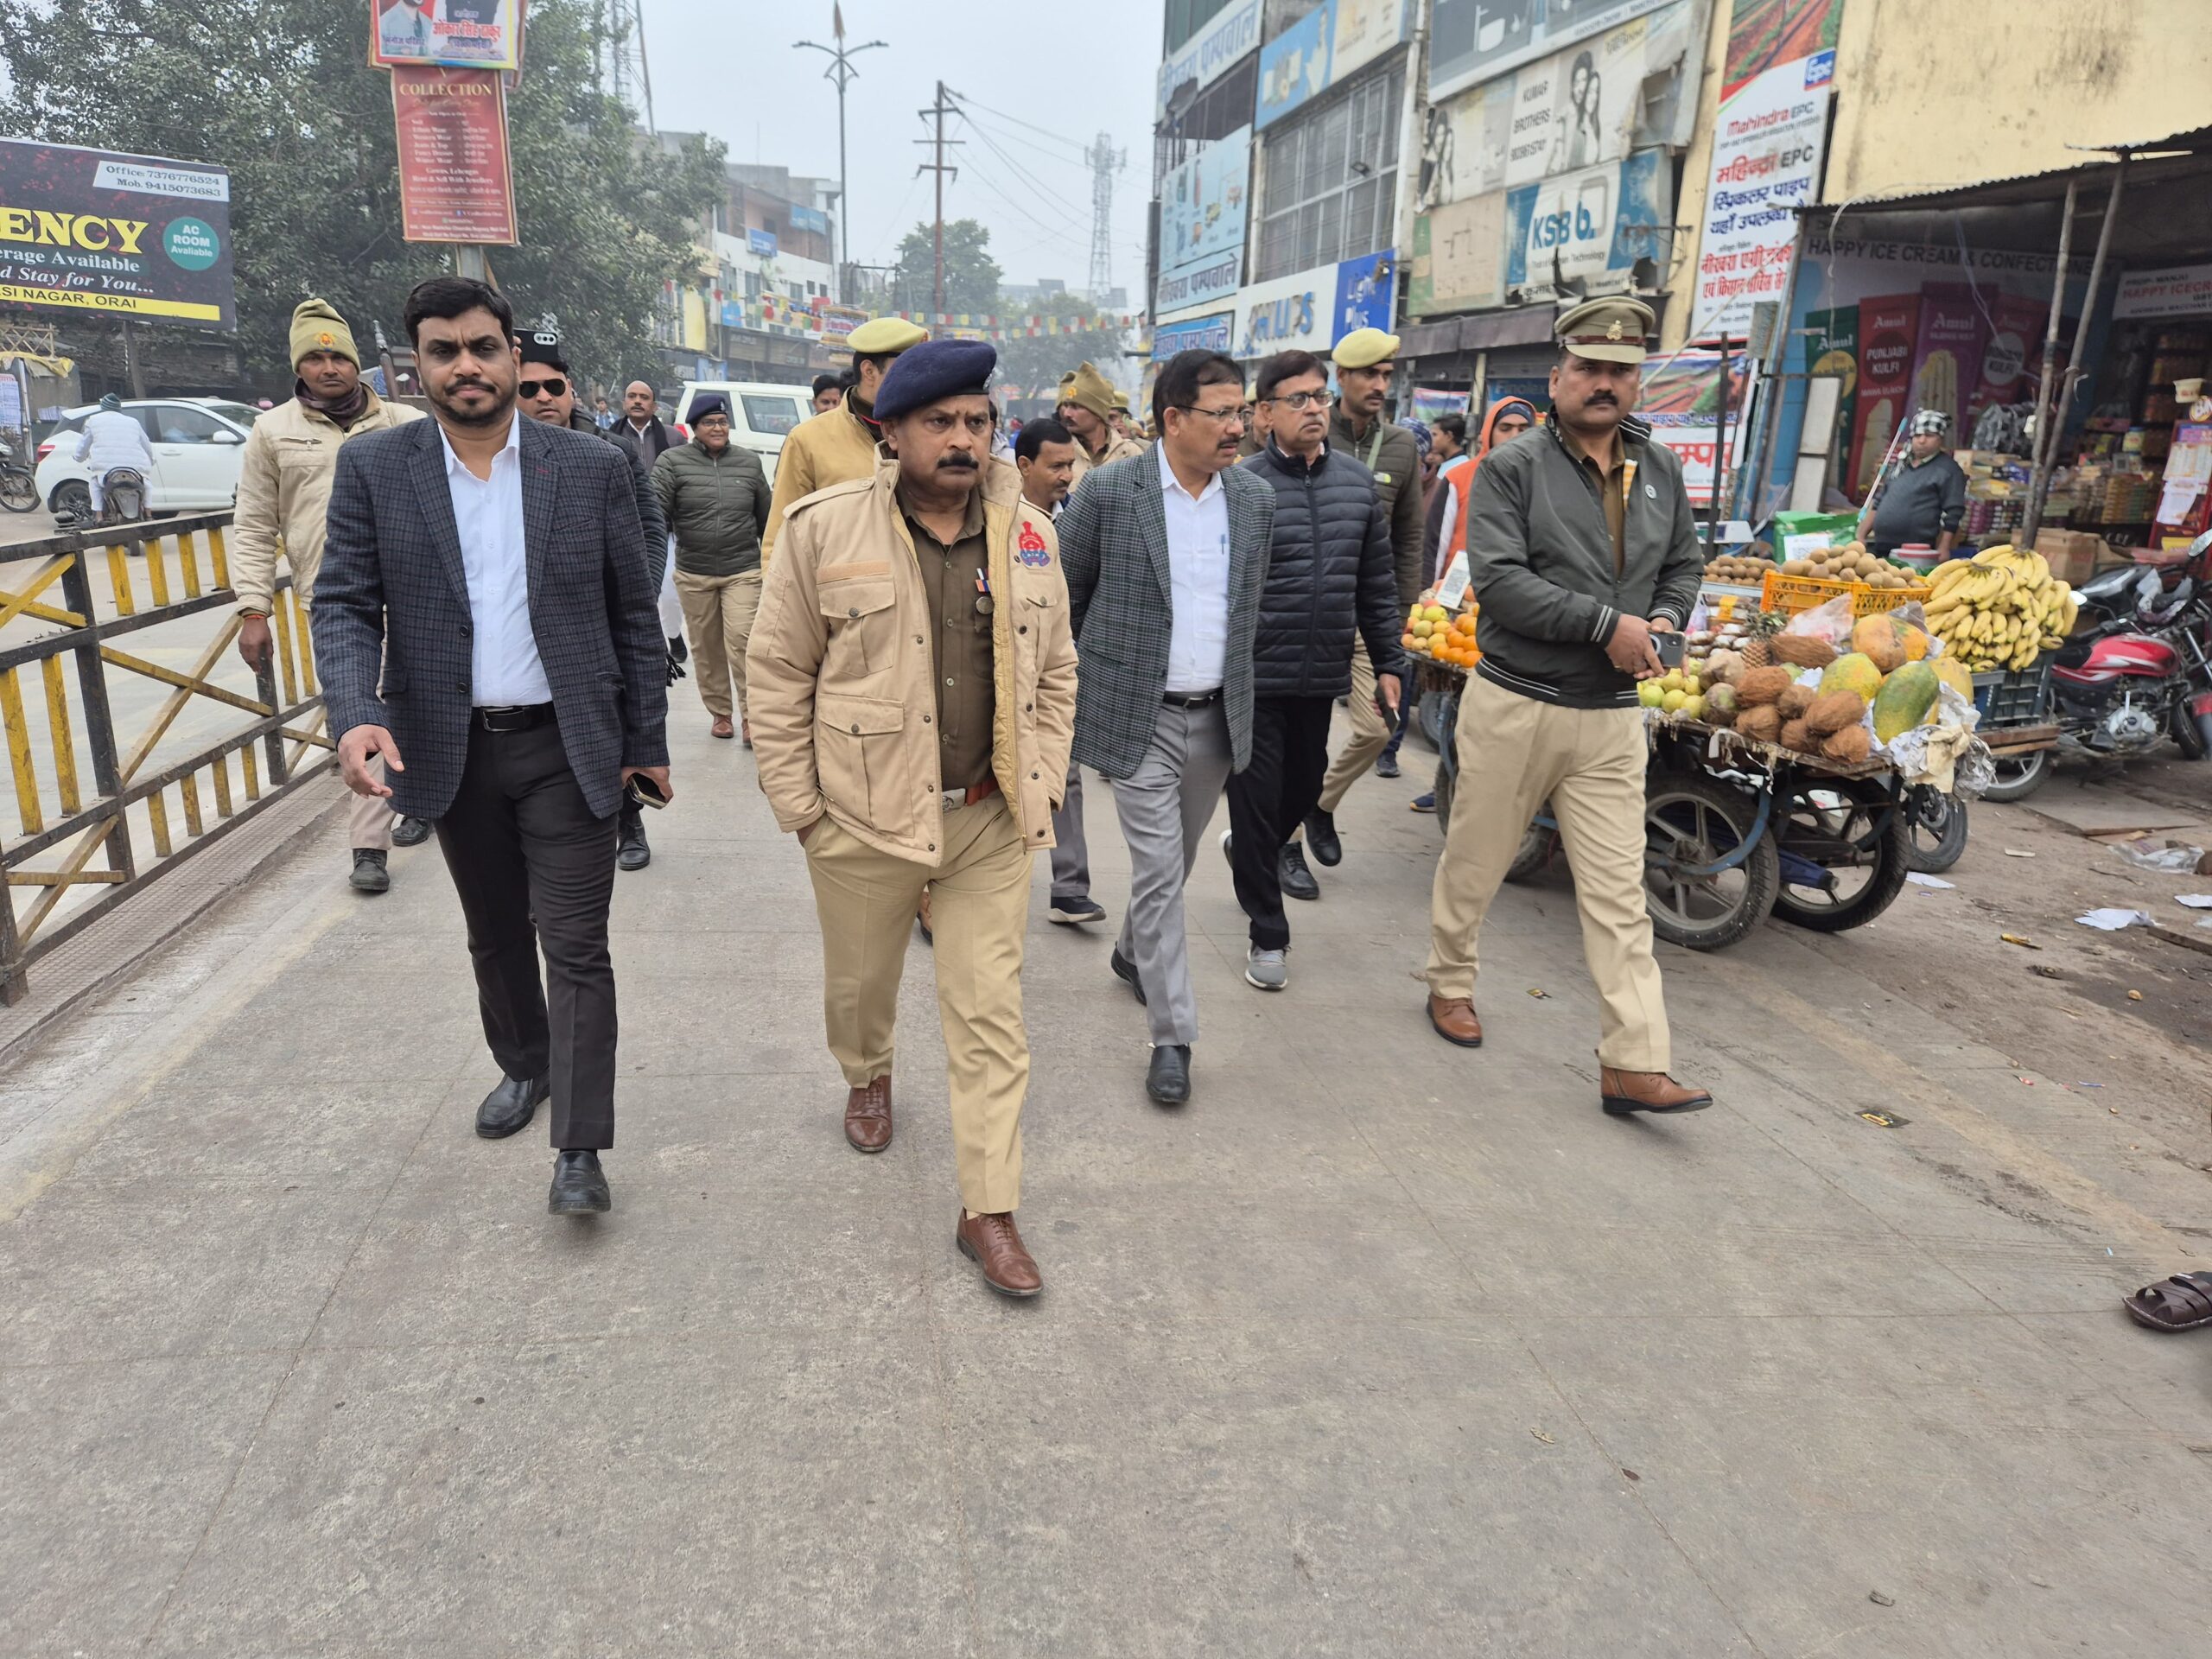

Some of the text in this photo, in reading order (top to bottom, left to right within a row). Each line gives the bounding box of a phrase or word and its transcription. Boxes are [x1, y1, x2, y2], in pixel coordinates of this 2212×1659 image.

[399, 83, 492, 96] COLLECTION
[1727, 108, 1789, 136] Mahindra
[1791, 101, 1815, 118] EPC
[1780, 145, 1814, 168] EPC
[147, 169, 219, 185] 7376776524
[1773, 176, 1811, 196] पाइप
[117, 178, 221, 197] Mob. 9415073683
[182, 225, 200, 235] AC
[1532, 211, 1571, 251] KSB
[173, 234, 211, 247] ROOM
[52, 251, 140, 273] Available
[1808, 238, 1868, 259] HAPPY
[1869, 241, 1898, 260] ICE
[1903, 245, 1961, 267] CREAM
[18, 268, 59, 284] Stay
[62, 272, 95, 288] for
[101, 275, 154, 293] You...
[23, 289, 89, 305] NAGAR,
[95, 296, 137, 309] ORAI
[1248, 291, 1315, 342] PHILIPS
[1872, 315, 1906, 329] Amul
[1931, 313, 1975, 331] Amul
[1816, 334, 1853, 351] Amul
[1866, 346, 1909, 359] PUNJABI
[1872, 363, 1900, 375] KULFI
